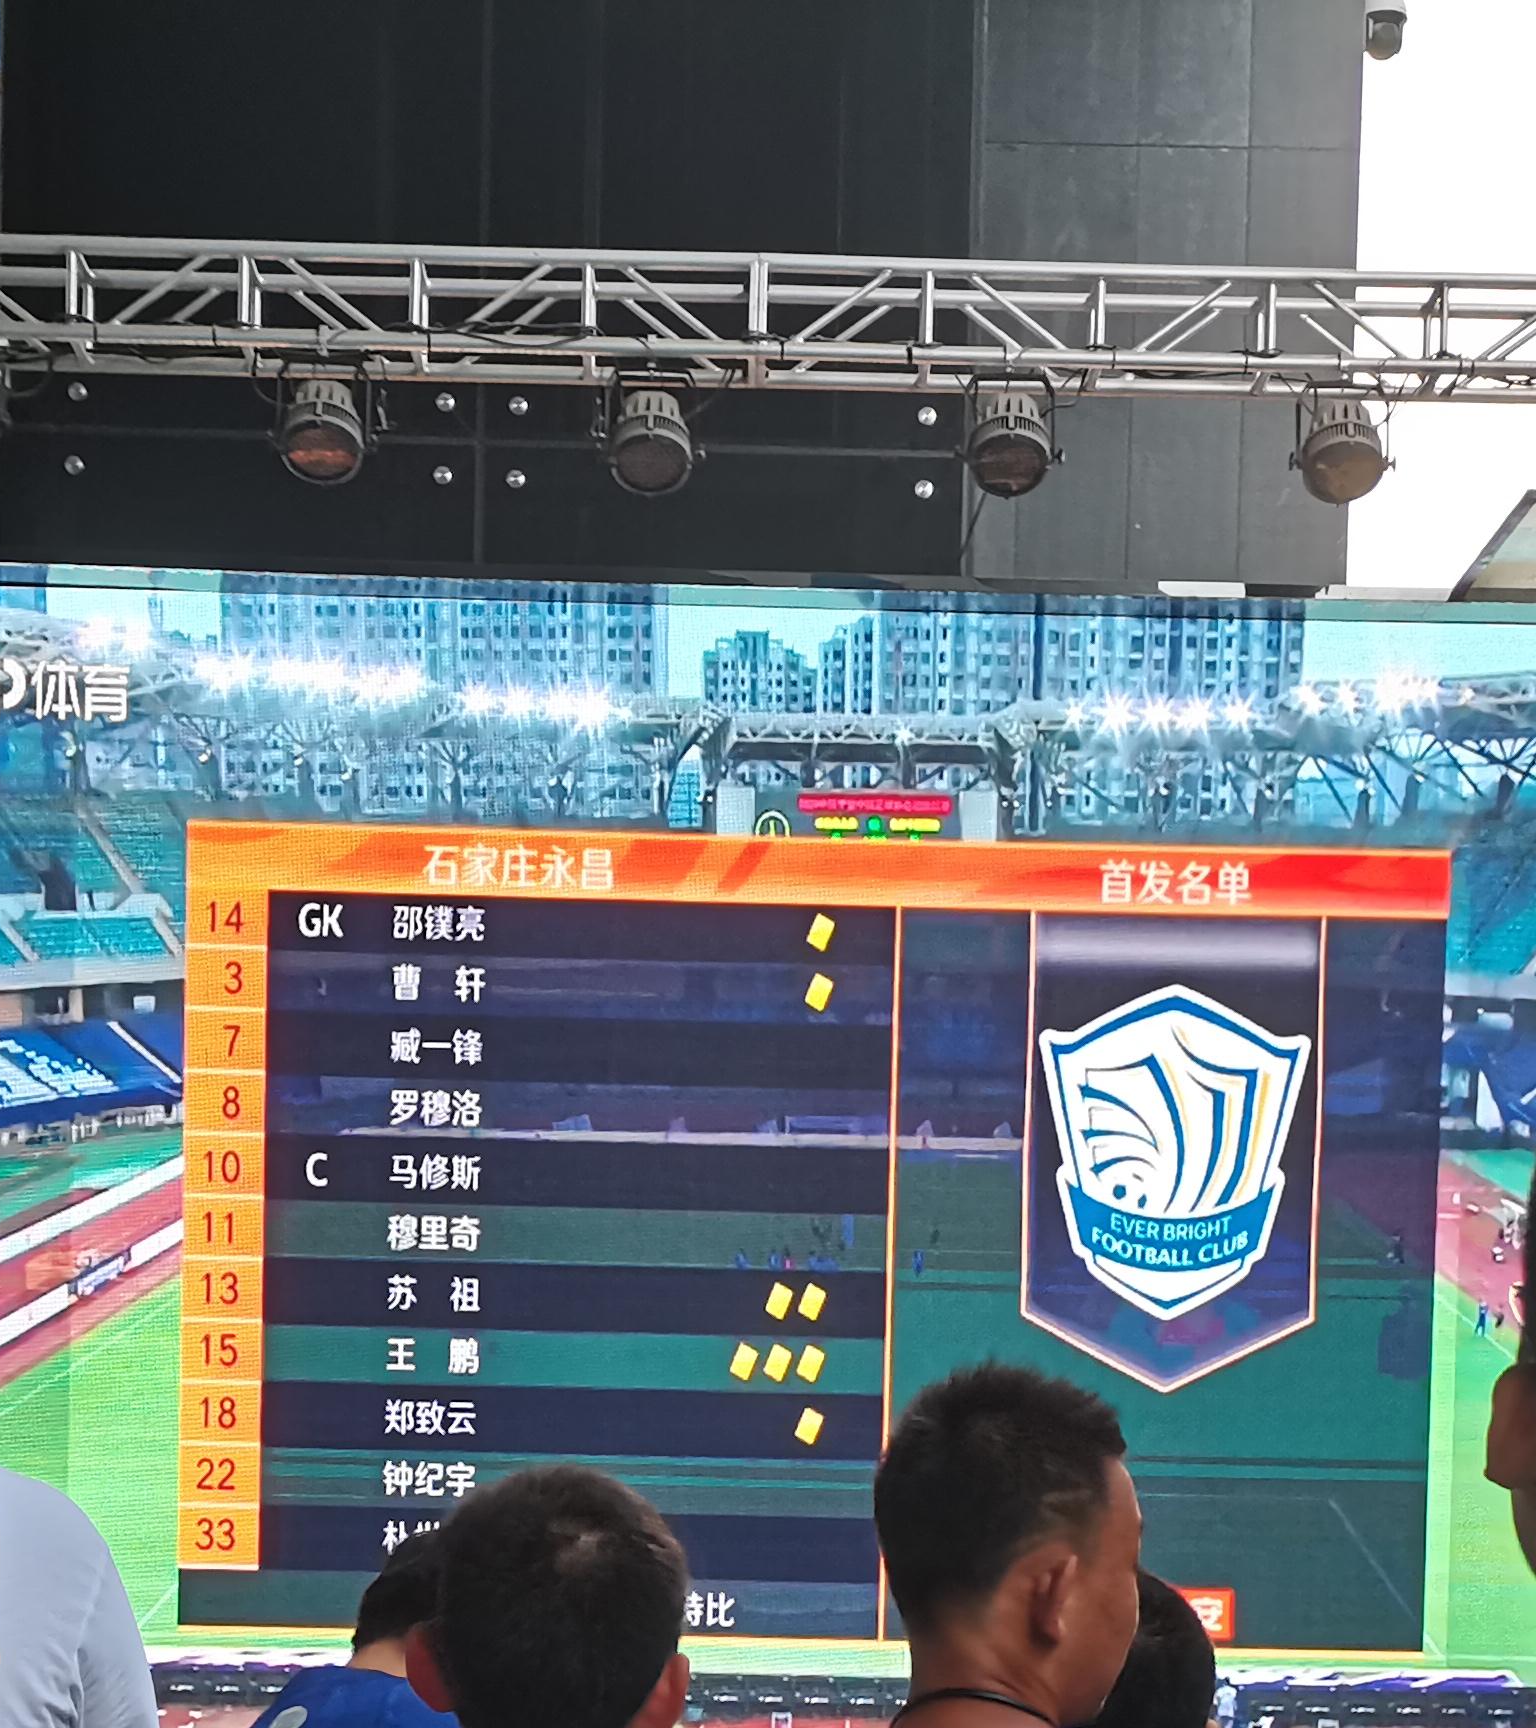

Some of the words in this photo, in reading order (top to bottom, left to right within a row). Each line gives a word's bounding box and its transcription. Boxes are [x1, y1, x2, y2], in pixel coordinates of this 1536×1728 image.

[423, 844, 615, 890] 石家庄永昌
[1099, 860, 1251, 906] 首发名单
[207, 901, 244, 934] 14
[297, 903, 344, 938] GK
[224, 962, 243, 995] 3
[224, 1025, 241, 1057] 7
[222, 1086, 241, 1120] 8
[390, 1090, 482, 1127] 罗穆洛
[203, 1150, 240, 1183] 10
[305, 1153, 328, 1187] C
[389, 1154, 481, 1191] 马修斯
[202, 1212, 236, 1245] 11
[387, 1214, 481, 1252] 穆里奇
[1110, 1212, 1160, 1240] EVER
[1163, 1214, 1232, 1242] BRIGHT
[1091, 1229, 1194, 1267] FOOTBALL
[1198, 1229, 1249, 1264] CLUB
[202, 1272, 239, 1306] 13
[200, 1334, 238, 1368] 15
[200, 1396, 237, 1429] 18
[384, 1401, 476, 1436] 郑致云
[195, 1457, 236, 1491] 22
[383, 1462, 476, 1498] 钟纪宇
[194, 1518, 236, 1551] 33
